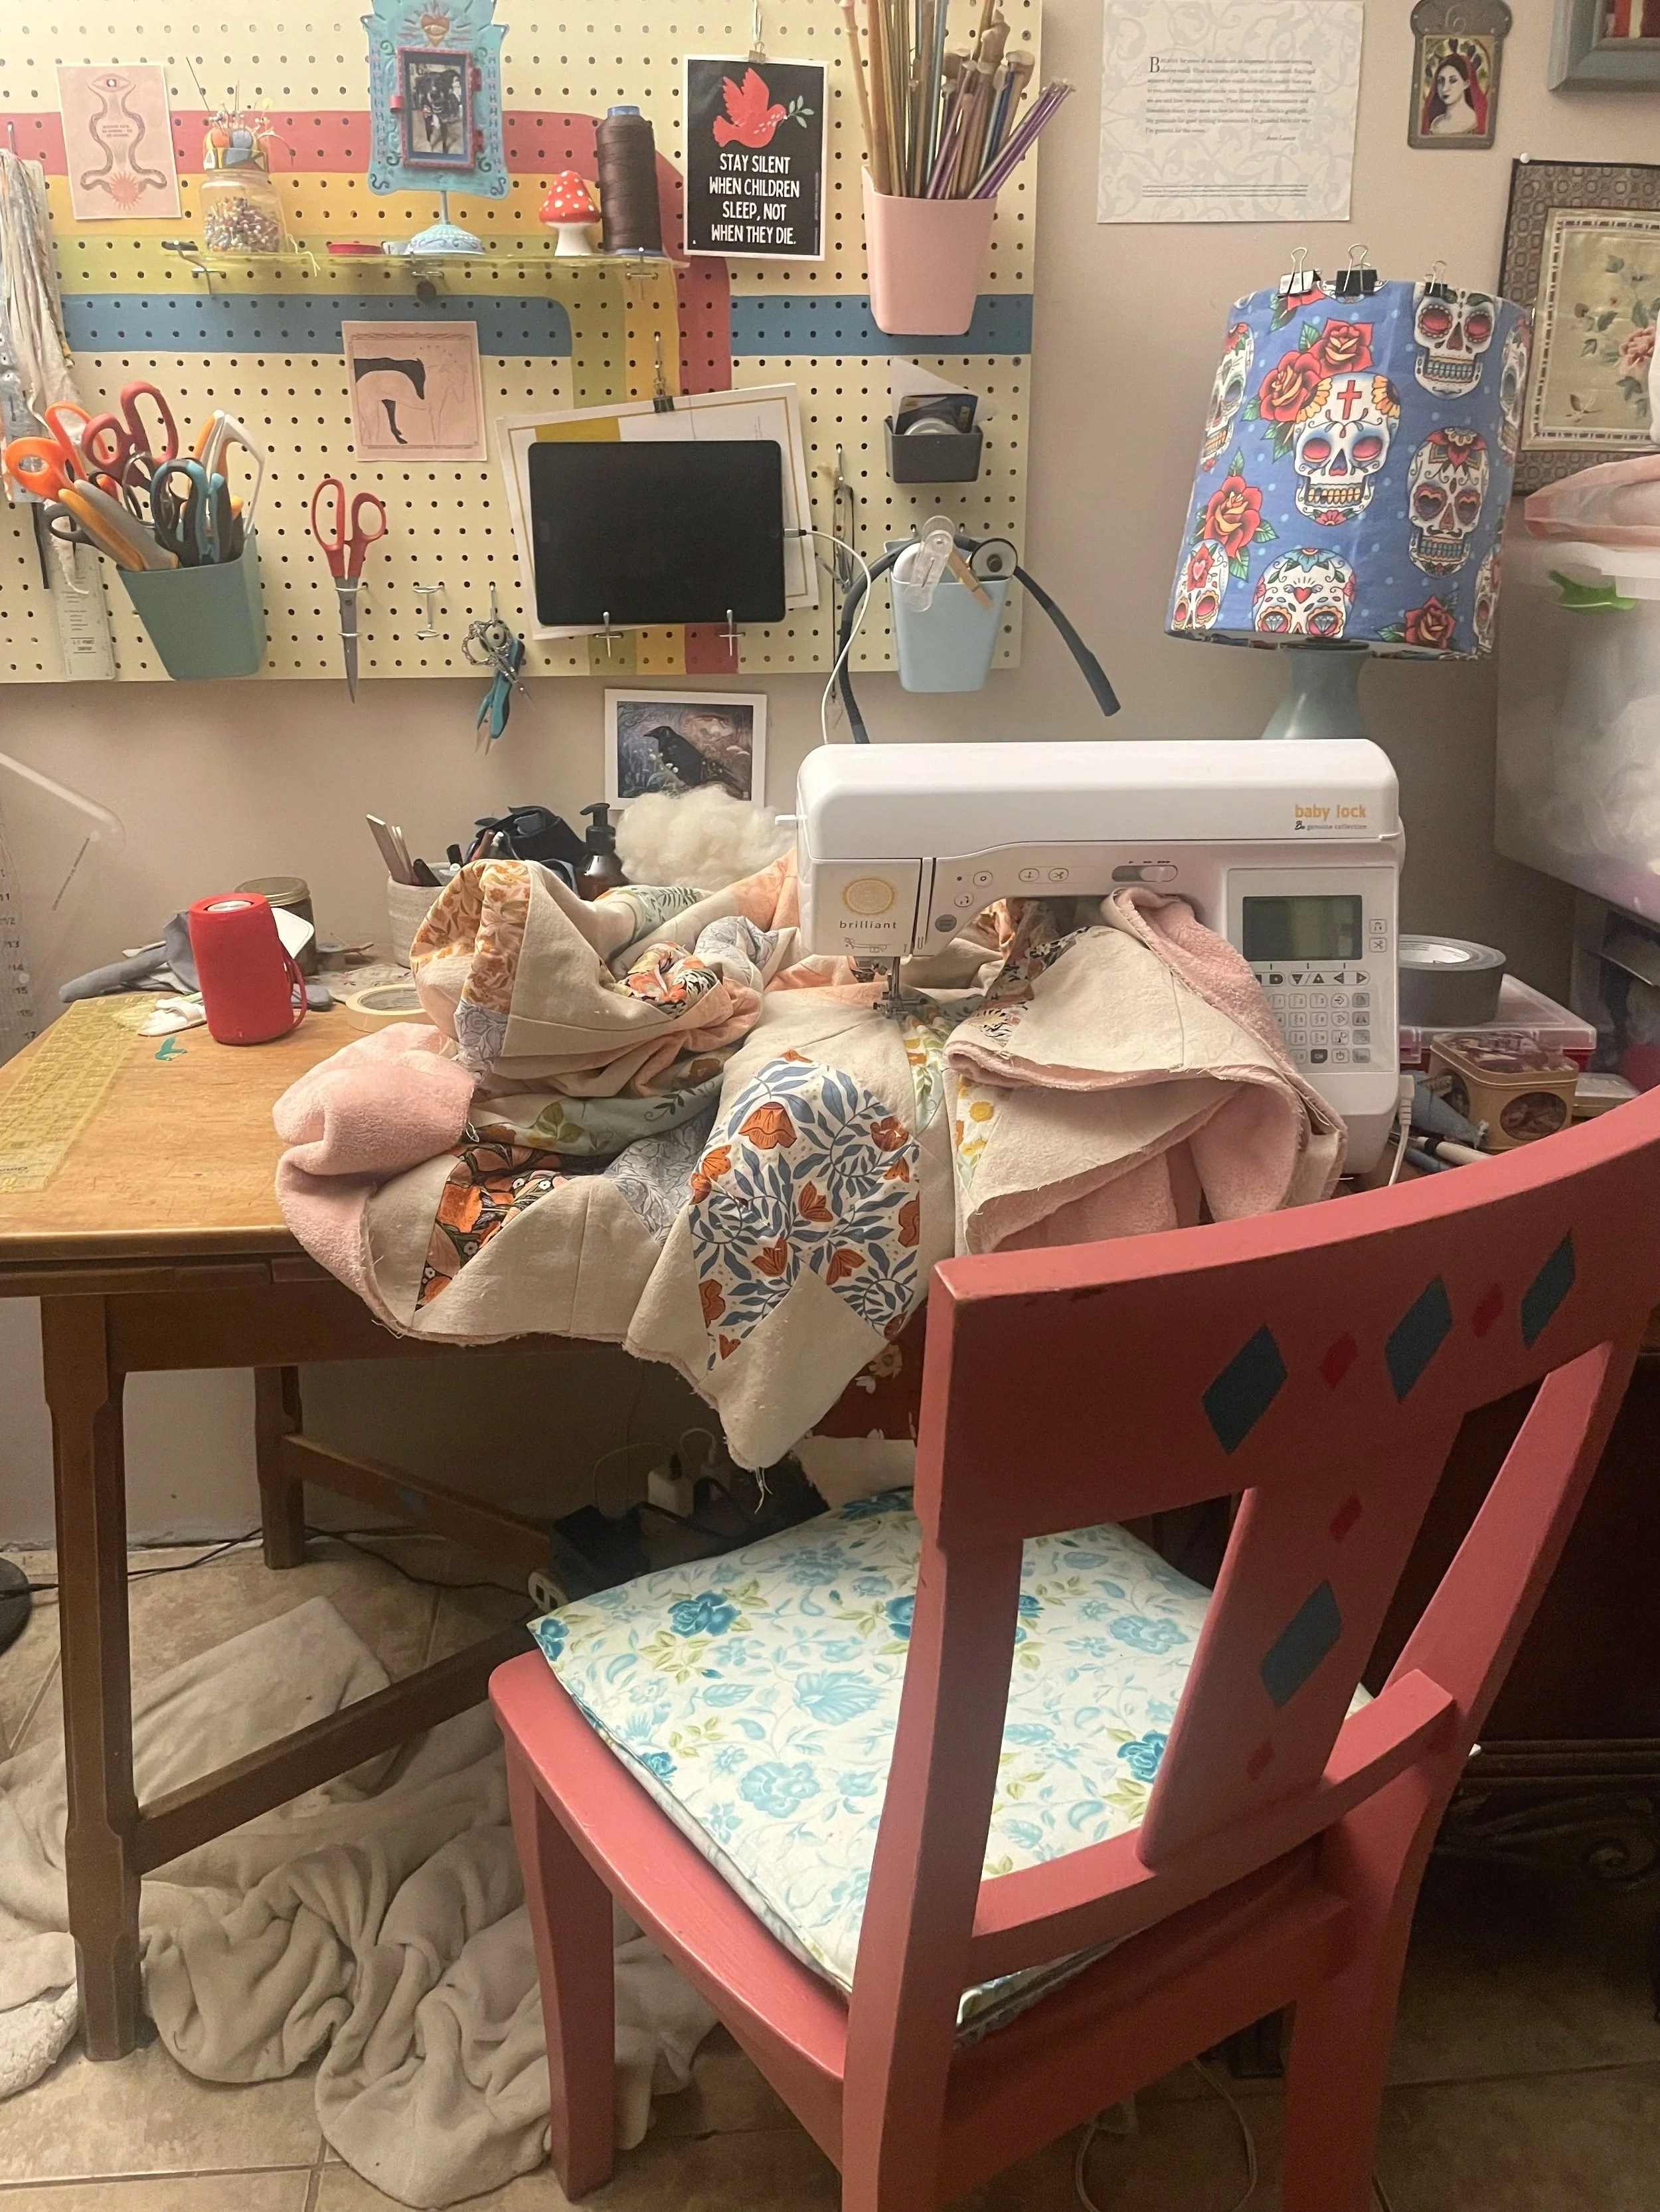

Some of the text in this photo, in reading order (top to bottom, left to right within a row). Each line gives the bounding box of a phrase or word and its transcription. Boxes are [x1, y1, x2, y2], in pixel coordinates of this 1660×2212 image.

[720, 153, 791, 174] STAY SILENT
[709, 176, 799, 198] WHEN CHILDREN
[722, 201, 787, 221] SLEEP, NOT
[711, 224, 744, 242] WHEN
[746, 226, 773, 243] THEY
[776, 227, 796, 244] DIE.
[1295, 803, 1367, 821] baby lock
[839, 920, 896, 929] brilliant
